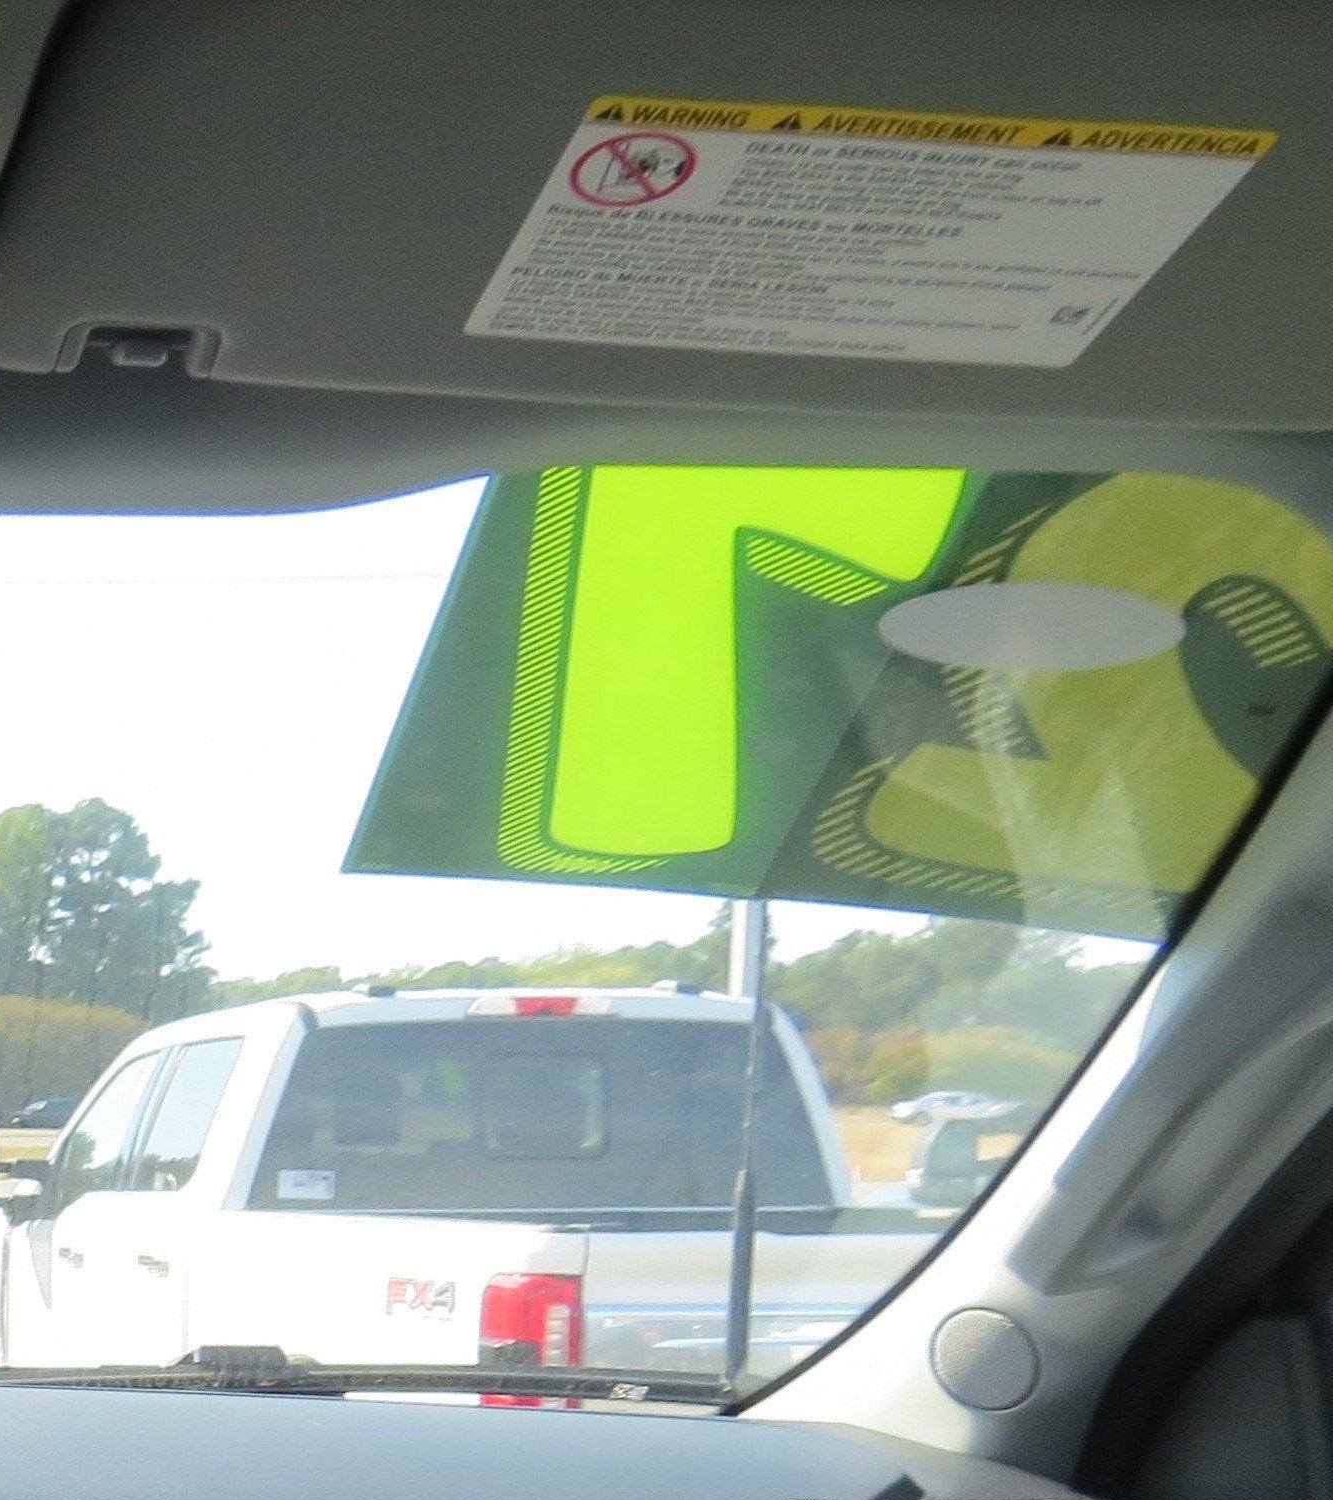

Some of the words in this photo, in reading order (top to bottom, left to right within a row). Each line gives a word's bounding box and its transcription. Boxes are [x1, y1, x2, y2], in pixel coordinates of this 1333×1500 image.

[633, 104, 751, 129] WARNING
[813, 113, 1026, 142] AVERTISSEMENT
[1083, 129, 1263, 155] ADVERTENCIA
[386, 1277, 456, 1316] FX4
